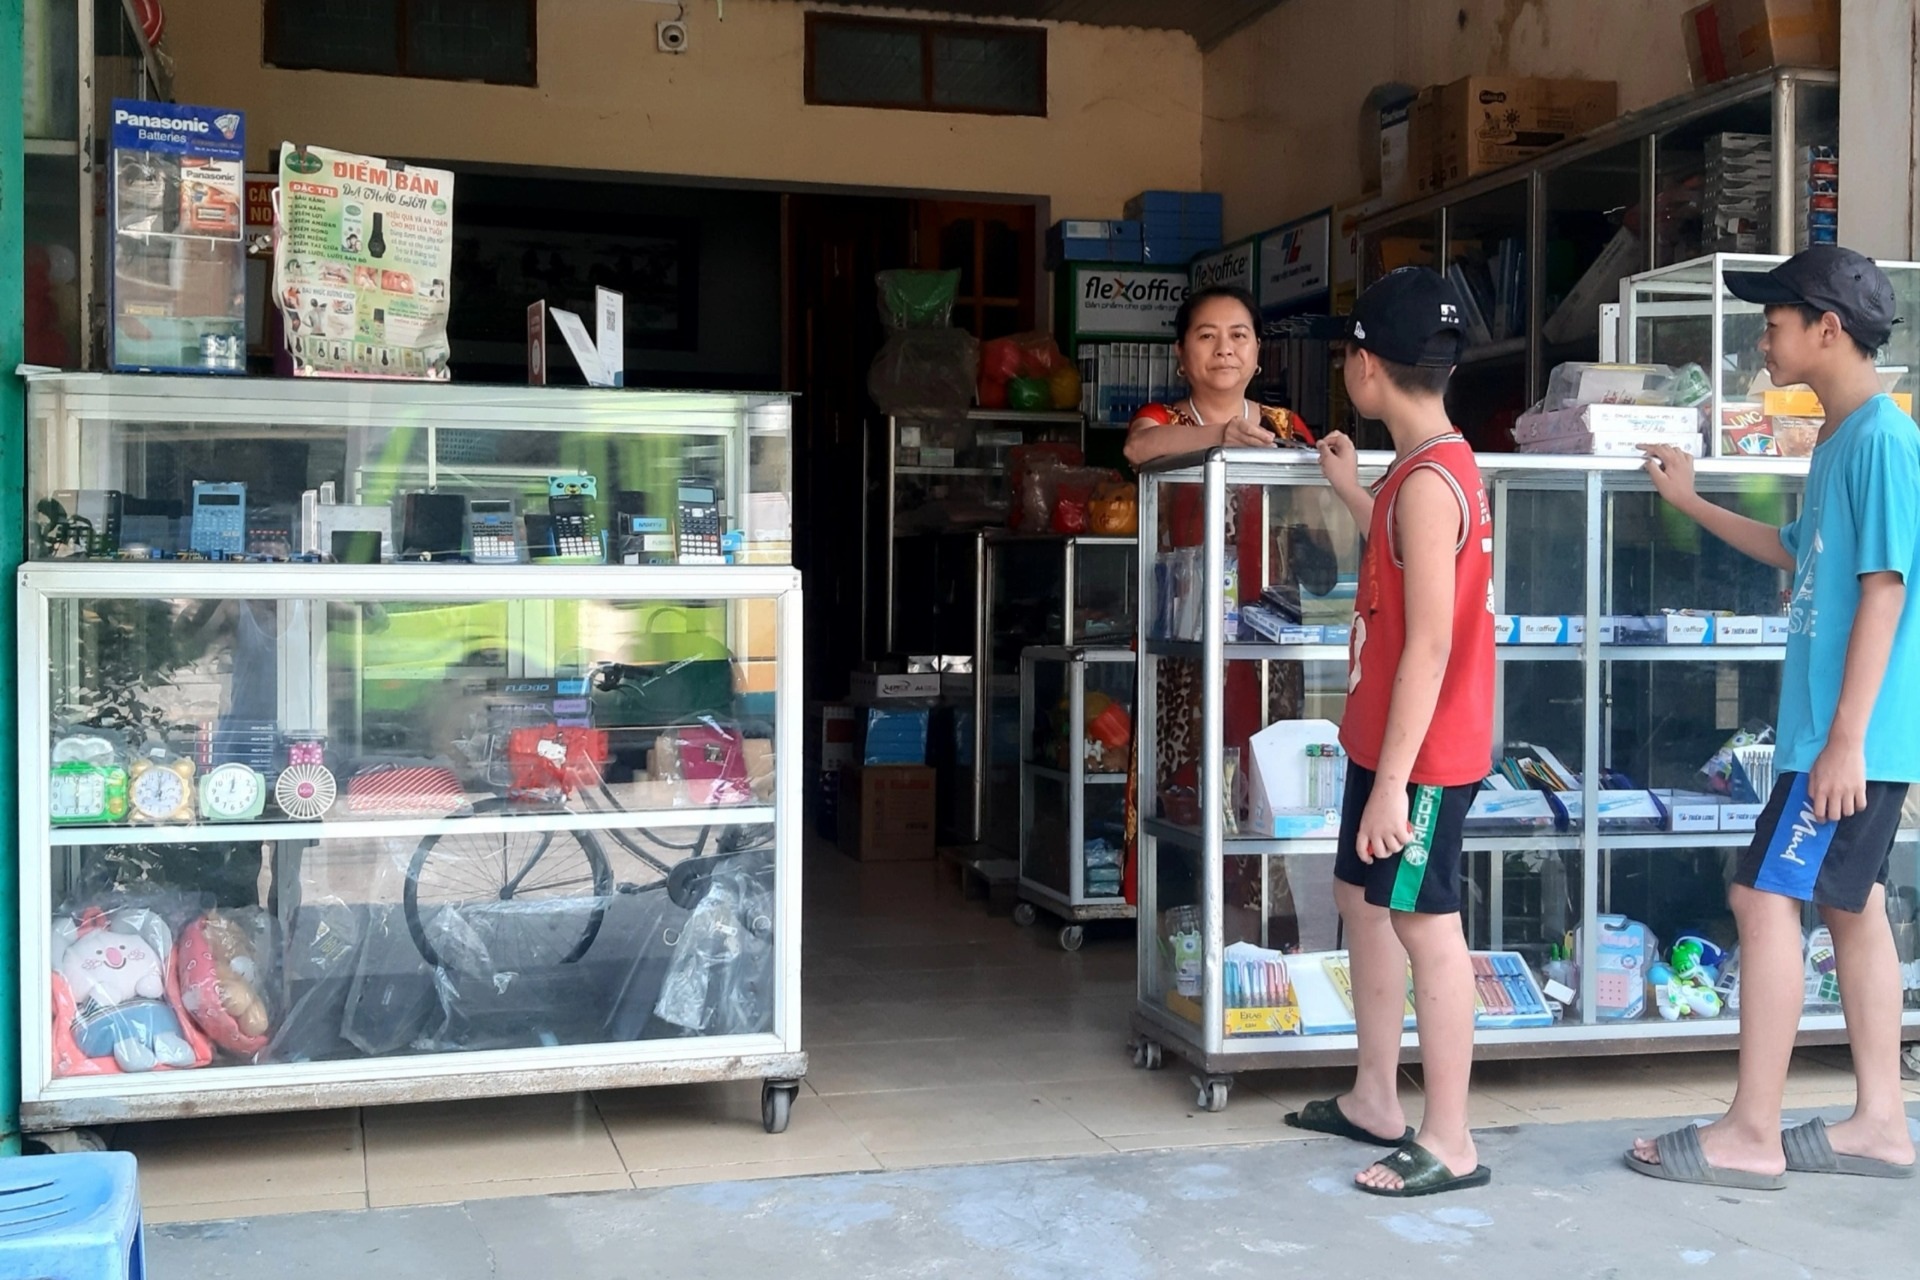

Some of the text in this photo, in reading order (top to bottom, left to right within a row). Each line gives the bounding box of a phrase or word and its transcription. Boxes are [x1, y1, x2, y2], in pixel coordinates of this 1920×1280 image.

[114, 109, 210, 133] Panasonic
[138, 129, 187, 143] Batteries
[186, 170, 235, 182] Panasonic
[333, 159, 439, 196] ĐIỂM BÁN
[293, 183, 335, 196] ĐẶC TRỊ
[1085, 276, 1192, 303] flexoffice
[1412, 785, 1437, 844] RIGOR
[1240, 1011, 1262, 1020] ERAS
